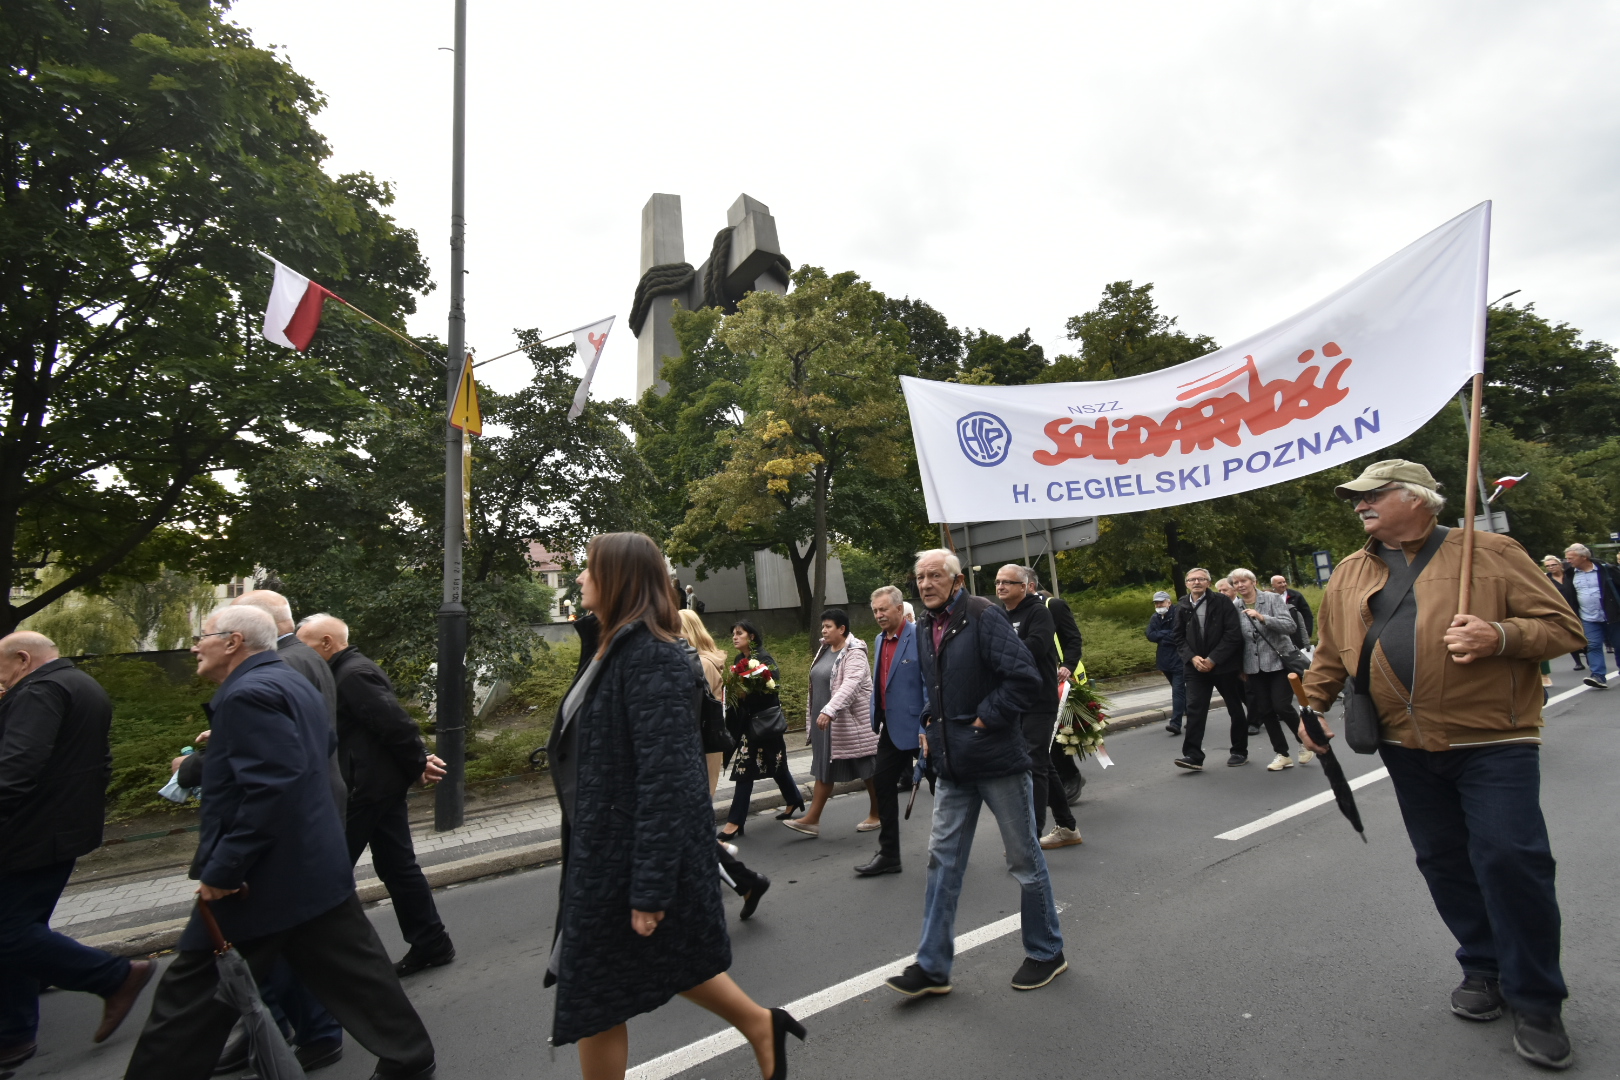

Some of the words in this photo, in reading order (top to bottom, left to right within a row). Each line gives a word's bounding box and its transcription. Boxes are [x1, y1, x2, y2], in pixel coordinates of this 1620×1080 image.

[1067, 401, 1123, 415] NSZZ
[1013, 484, 1036, 503] H.
[1046, 464, 1210, 502] CEGIELSKI
[1222, 406, 1381, 482] POZNAŃ
